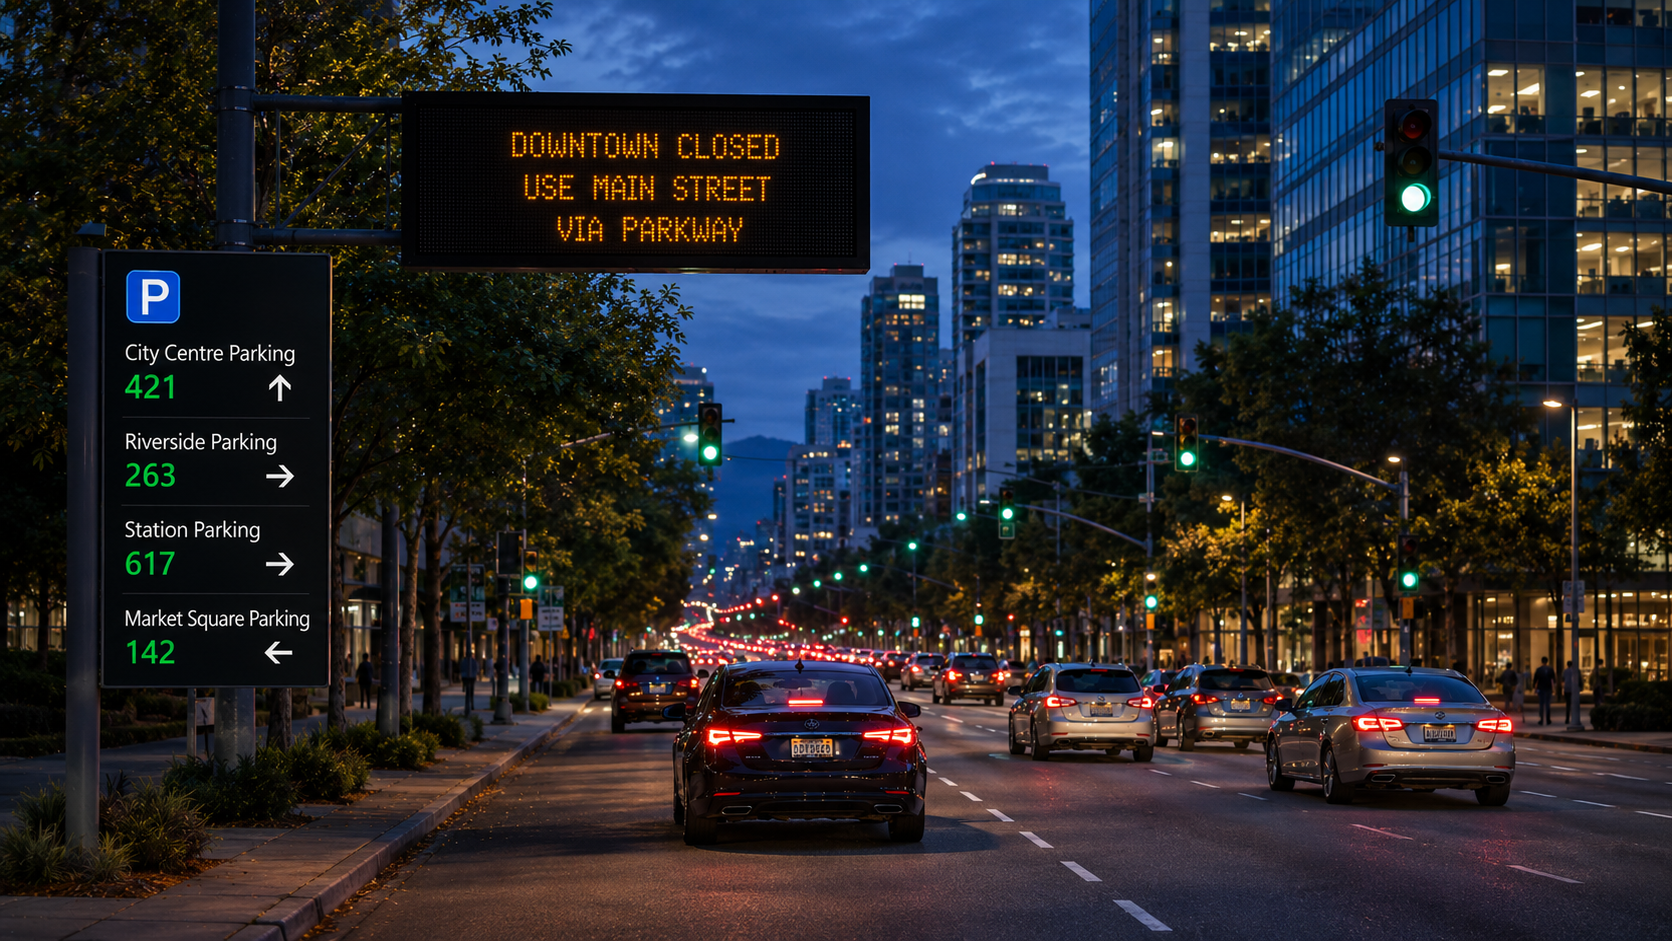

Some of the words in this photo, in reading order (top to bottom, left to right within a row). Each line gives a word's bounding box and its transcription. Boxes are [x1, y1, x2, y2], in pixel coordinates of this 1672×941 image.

[512, 132, 658, 158] DOWNTOWN
[678, 134, 779, 159] CLOSED
[525, 174, 574, 200] USE
[593, 175, 654, 200] MAIN
[673, 176, 771, 201] STREET
[557, 216, 603, 242] VIA
[623, 216, 743, 242] PARKWAY
[142, 278, 170, 315] P
[125, 343, 160, 366] City
[164, 343, 224, 362] Centre
[229, 343, 295, 367] Parking
[124, 374, 174, 399] 421
[125, 432, 206, 451] Riverside
[211, 432, 277, 456] Parking
[125, 462, 176, 488] 263
[125, 520, 188, 538] Station
[194, 519, 261, 544] Parking
[125, 550, 175, 576] 617
[125, 608, 184, 627] Market
[187, 609, 245, 632] Square
[249, 609, 310, 632] Parking
[126, 639, 175, 664] 142
